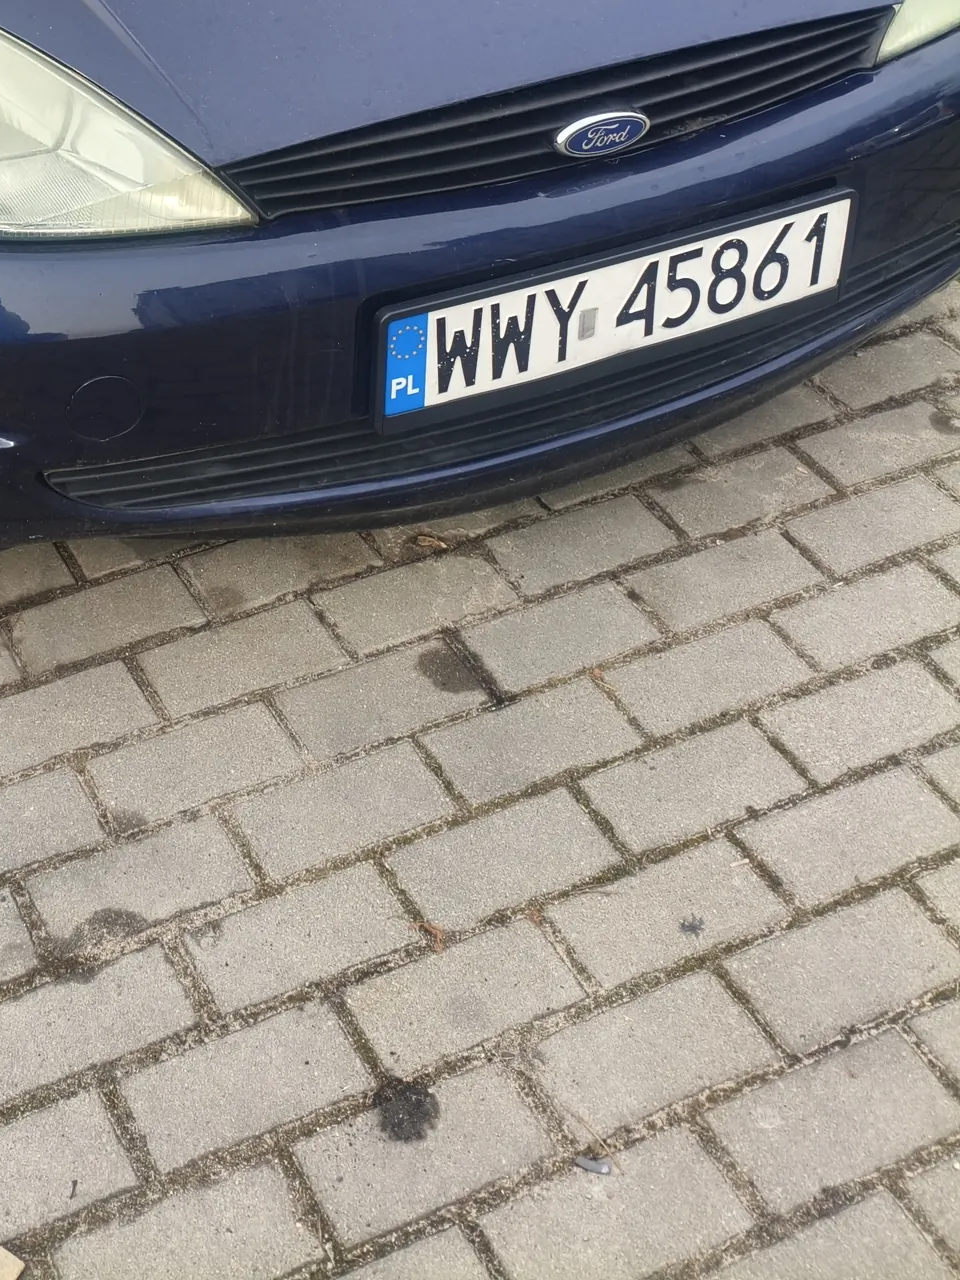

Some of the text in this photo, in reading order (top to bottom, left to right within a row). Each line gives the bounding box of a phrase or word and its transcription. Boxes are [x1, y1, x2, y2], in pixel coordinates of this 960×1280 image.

[581, 123, 631, 150] Ford
[435, 211, 830, 395] WWY 45861
[391, 374, 420, 400] PL
